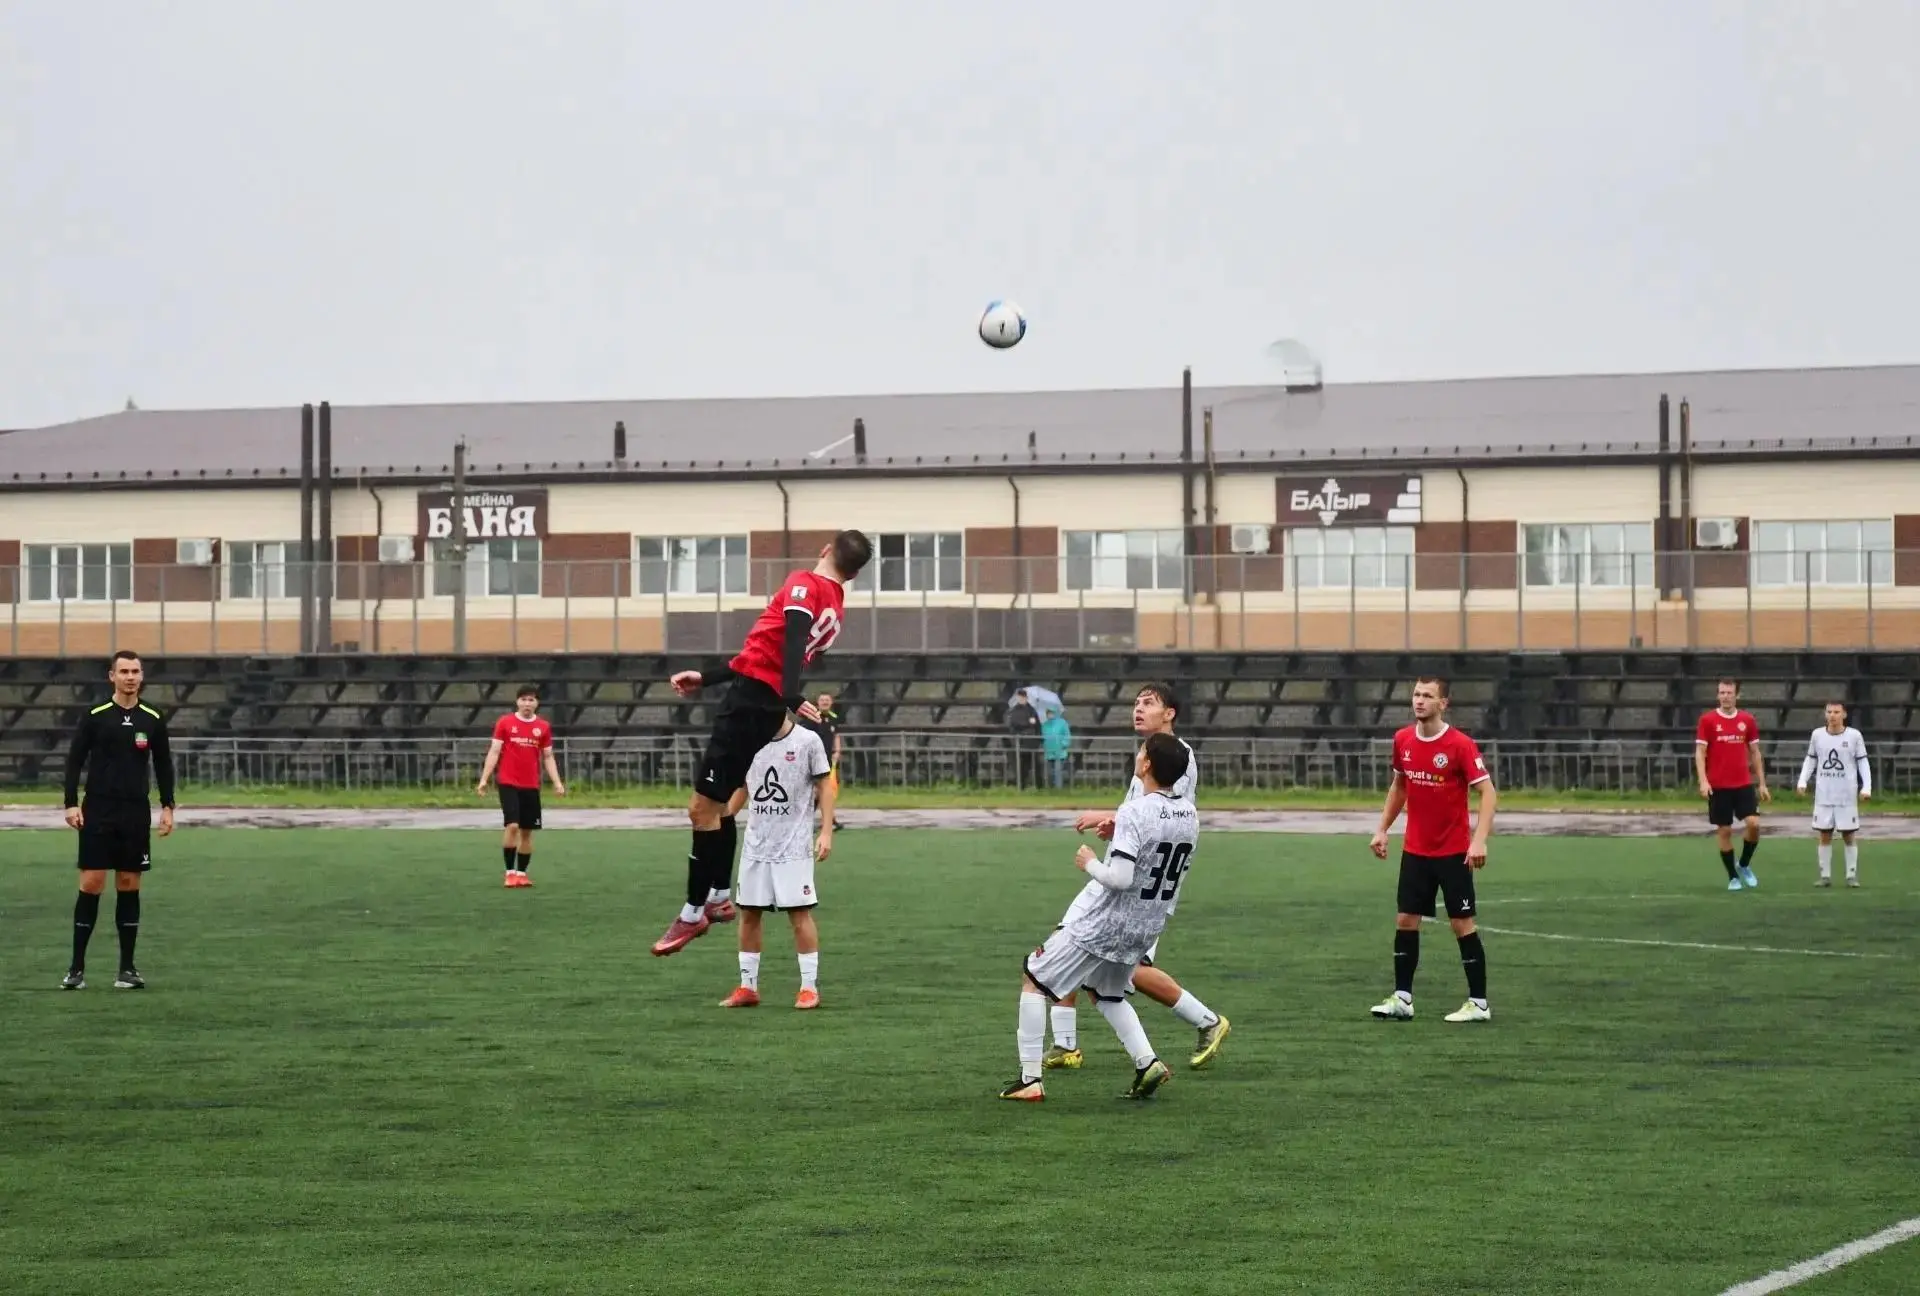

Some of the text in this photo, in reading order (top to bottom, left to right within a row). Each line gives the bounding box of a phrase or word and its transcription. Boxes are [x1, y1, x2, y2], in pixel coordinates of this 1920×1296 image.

[427, 506, 537, 538] БАНЯ
[1290, 479, 1371, 525] БАТЫР
[1140, 841, 1193, 901] 39
